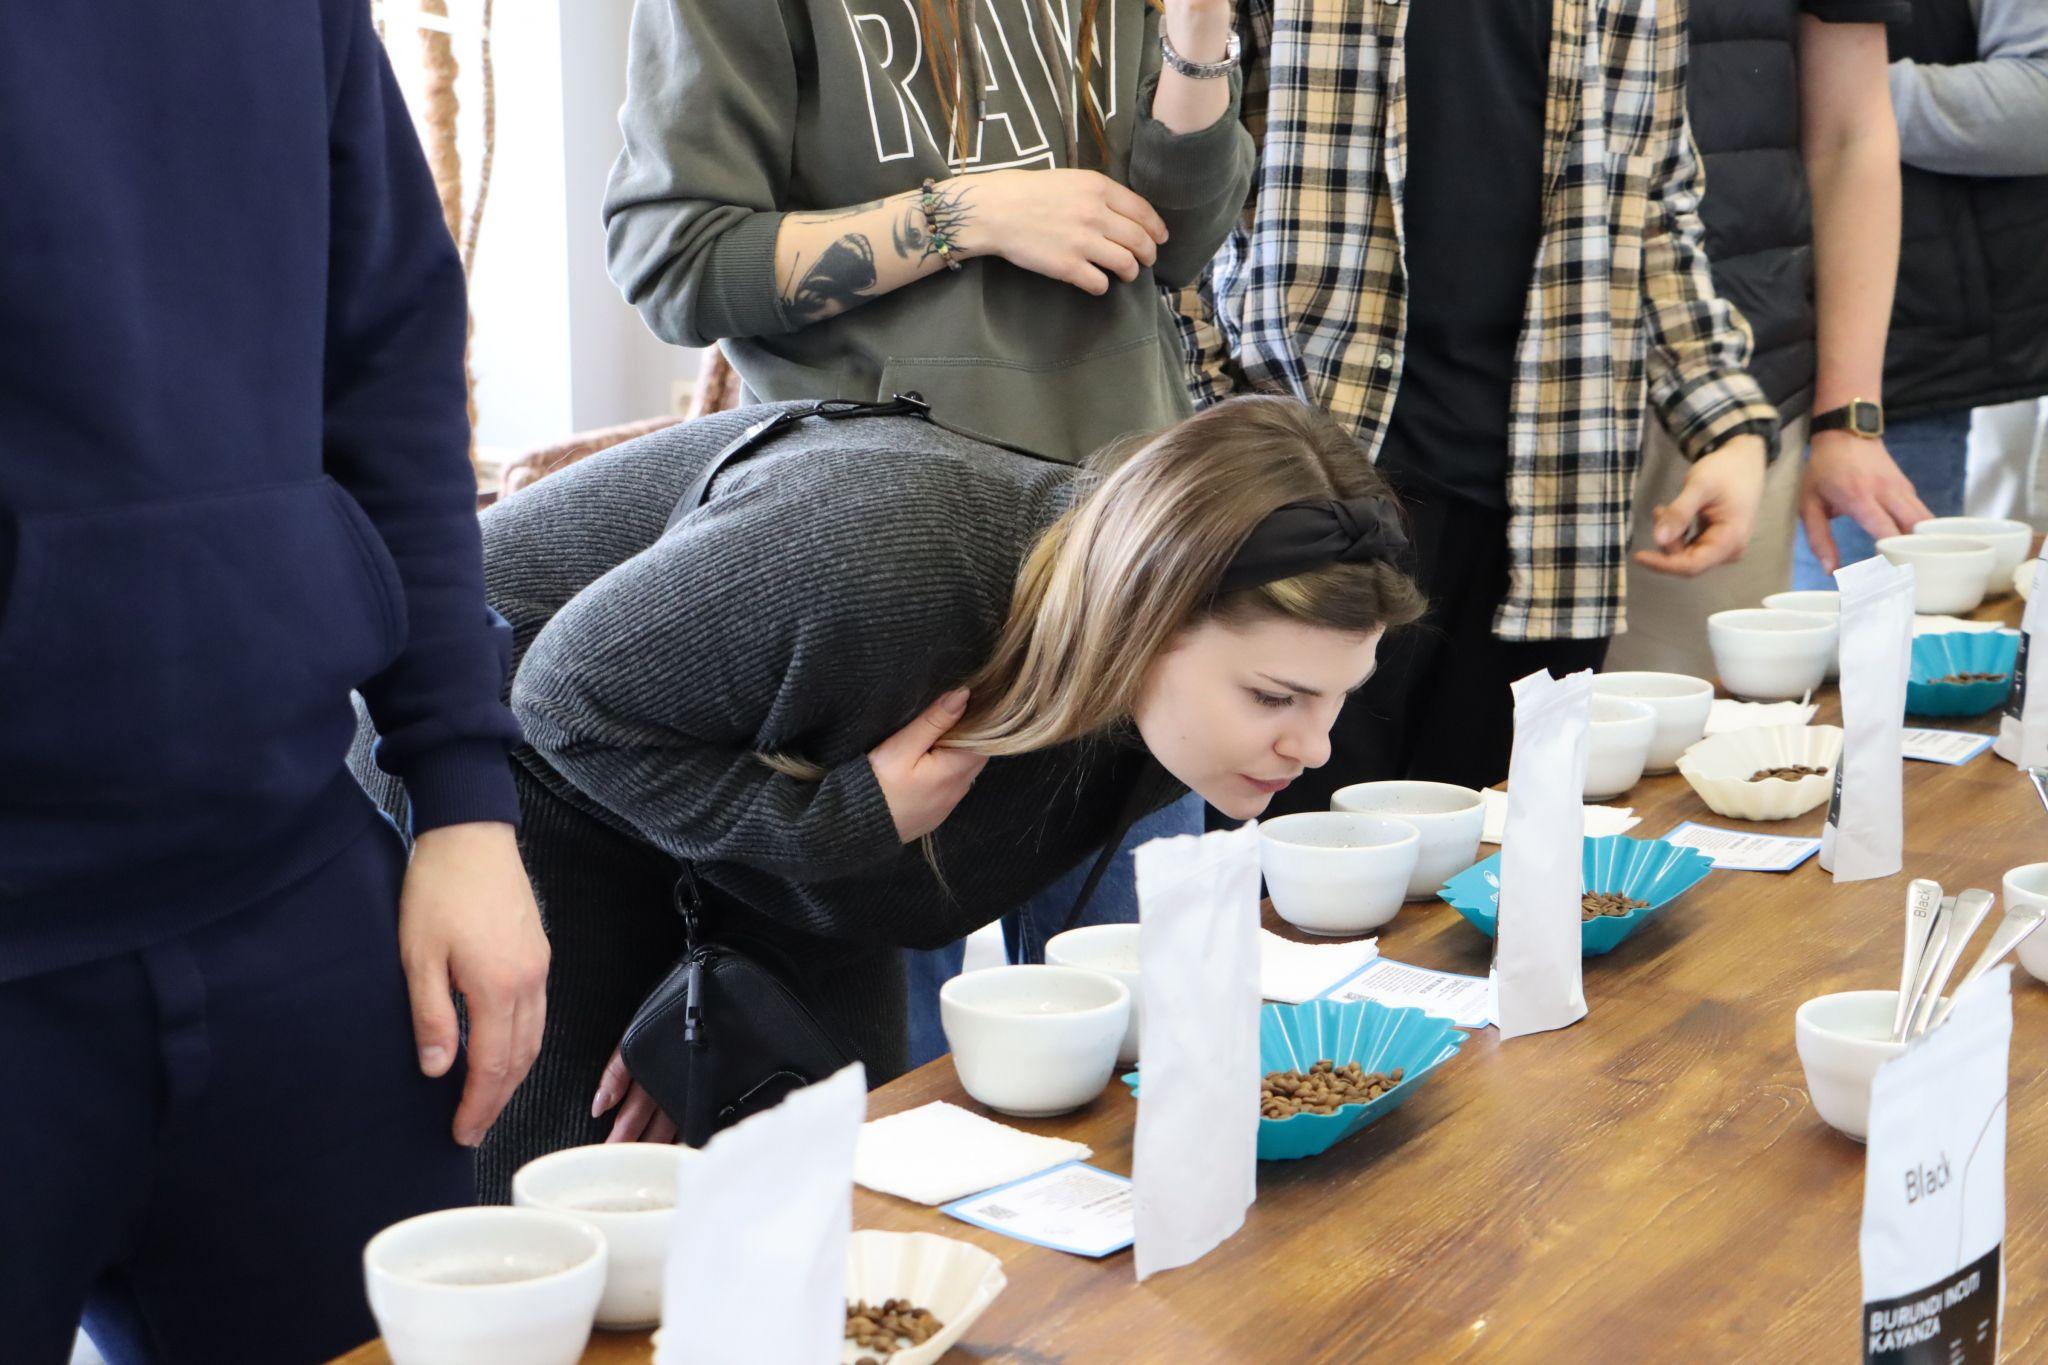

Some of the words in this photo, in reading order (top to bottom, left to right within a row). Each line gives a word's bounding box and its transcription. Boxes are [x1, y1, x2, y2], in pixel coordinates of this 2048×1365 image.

[1913, 889, 1932, 918] Black
[1870, 1292, 1944, 1333] BURUNDI
[1868, 1316, 1941, 1355] KAYANZA
